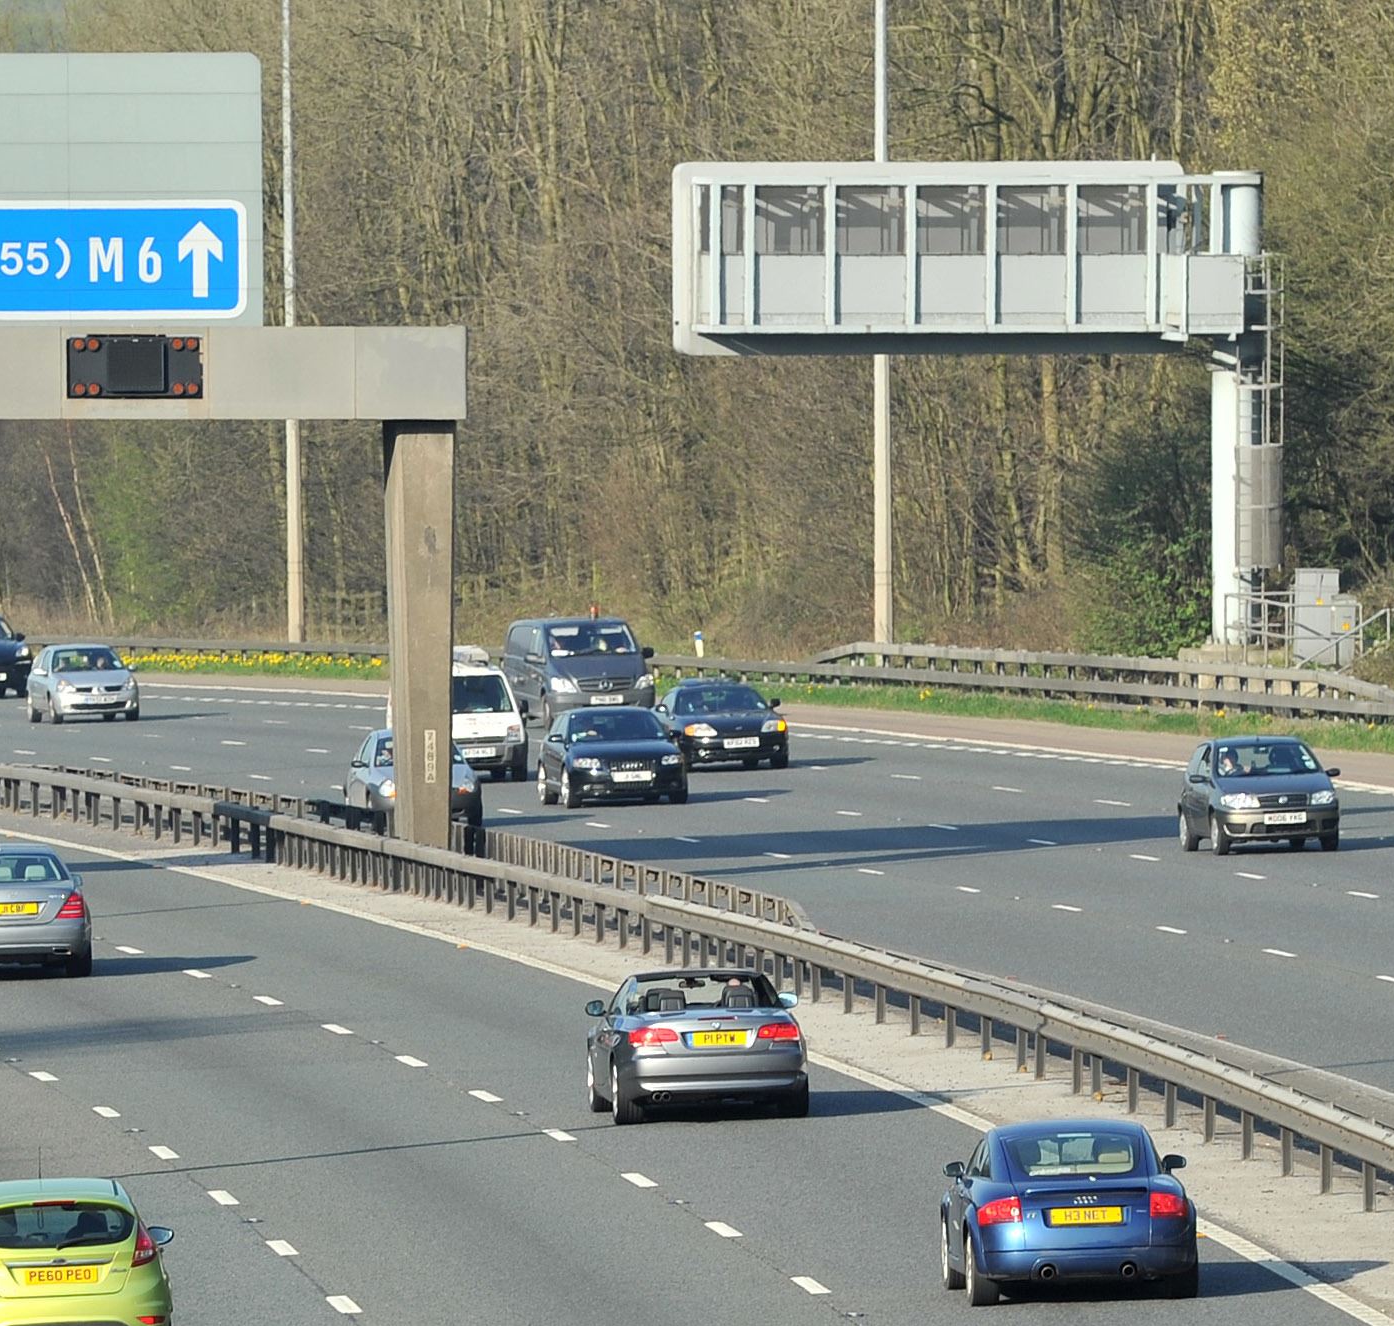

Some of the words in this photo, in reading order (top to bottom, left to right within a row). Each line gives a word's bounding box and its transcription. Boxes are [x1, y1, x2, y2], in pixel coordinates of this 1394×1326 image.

[88, 236, 162, 283] M6
[1064, 1211, 1081, 1221] H3
[1084, 1209, 1108, 1220] NET
[28, 1269, 63, 1282] PE60
[66, 1268, 92, 1281] PEO
